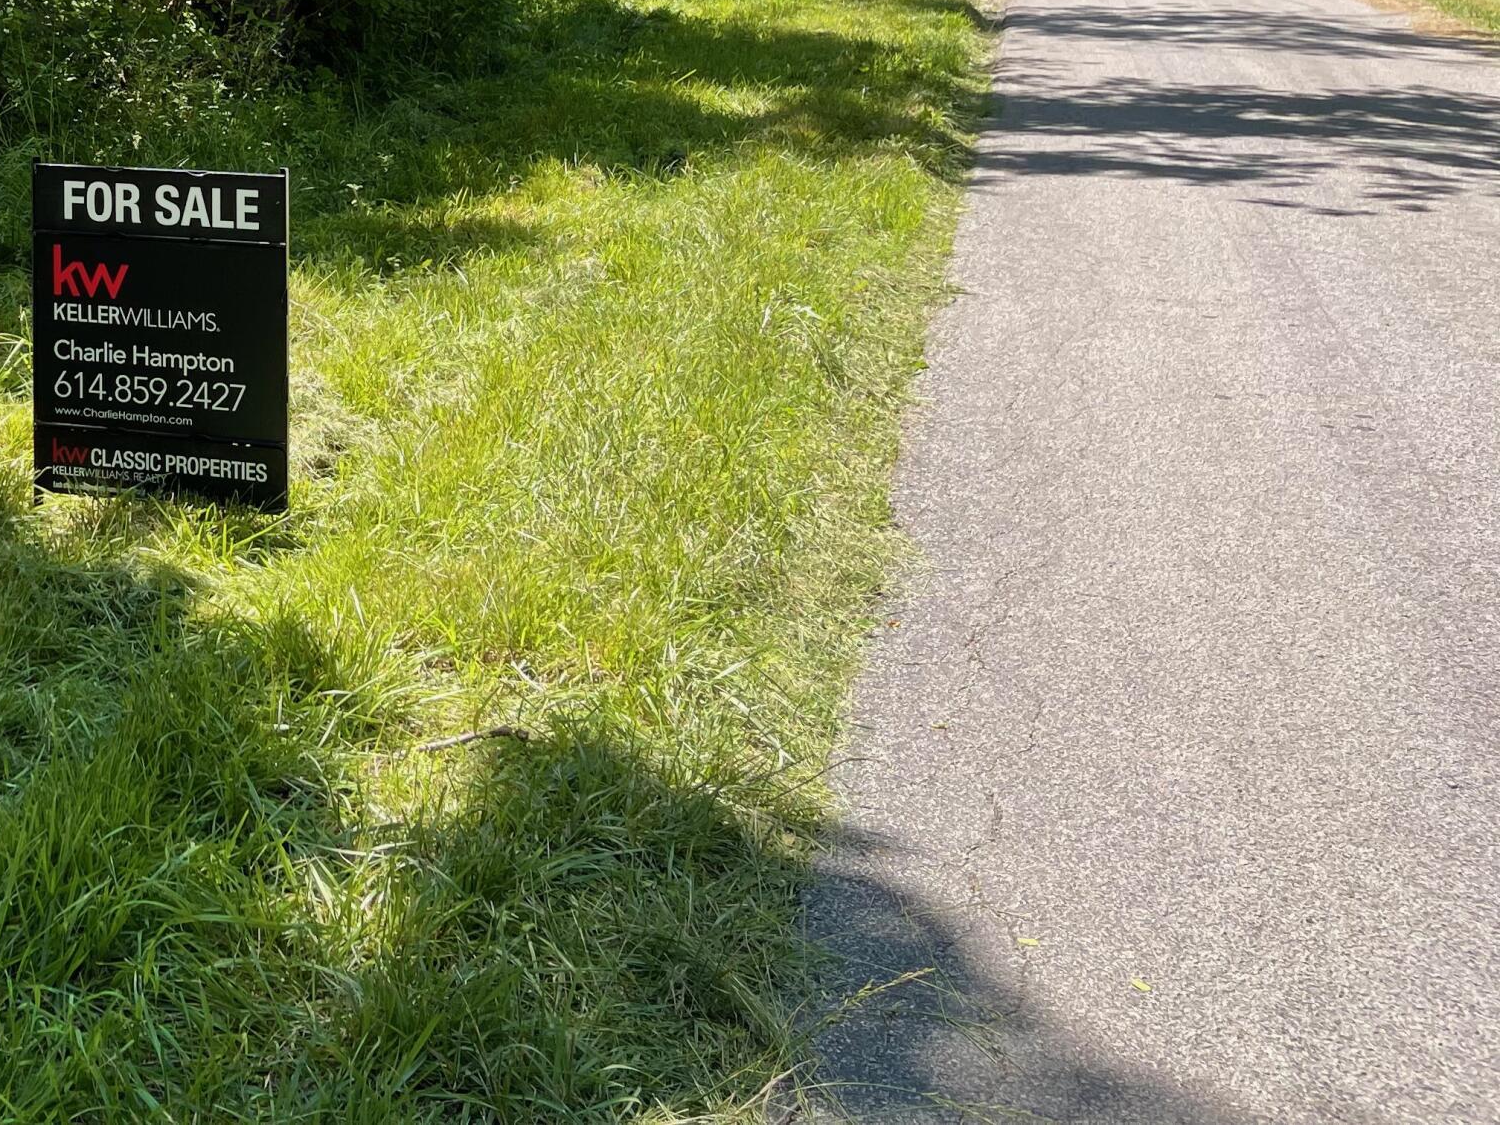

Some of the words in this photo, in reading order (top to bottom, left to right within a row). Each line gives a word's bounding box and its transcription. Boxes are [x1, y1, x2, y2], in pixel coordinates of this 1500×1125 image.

[63, 180, 141, 224] FOR
[154, 184, 260, 231] SALE
[52, 243, 130, 300] kw
[53, 338, 127, 365] Charlie
[132, 344, 234, 377] Hampton
[53, 370, 247, 412] 614.859.2427
[54, 406, 193, 426] www.CharlieHampton.com
[52, 437, 89, 465] kw
[90, 447, 162, 472] CLASSIC
[165, 454, 268, 483] PROPERTIES
